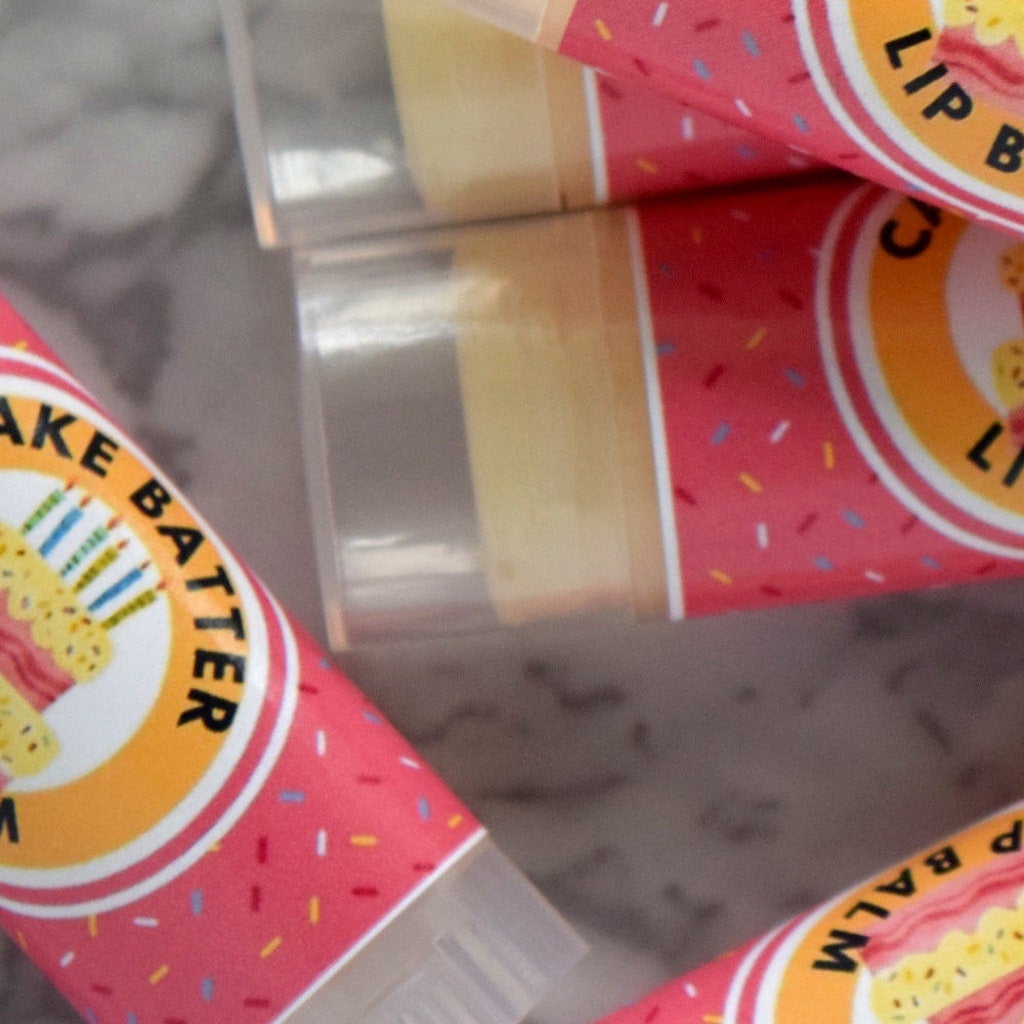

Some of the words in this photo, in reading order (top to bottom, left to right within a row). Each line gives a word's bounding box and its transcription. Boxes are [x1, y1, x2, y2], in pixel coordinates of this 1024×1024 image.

[884, 28, 973, 120] LIP
[130, 478, 247, 733] BATTER
[811, 845, 962, 974] BALM
